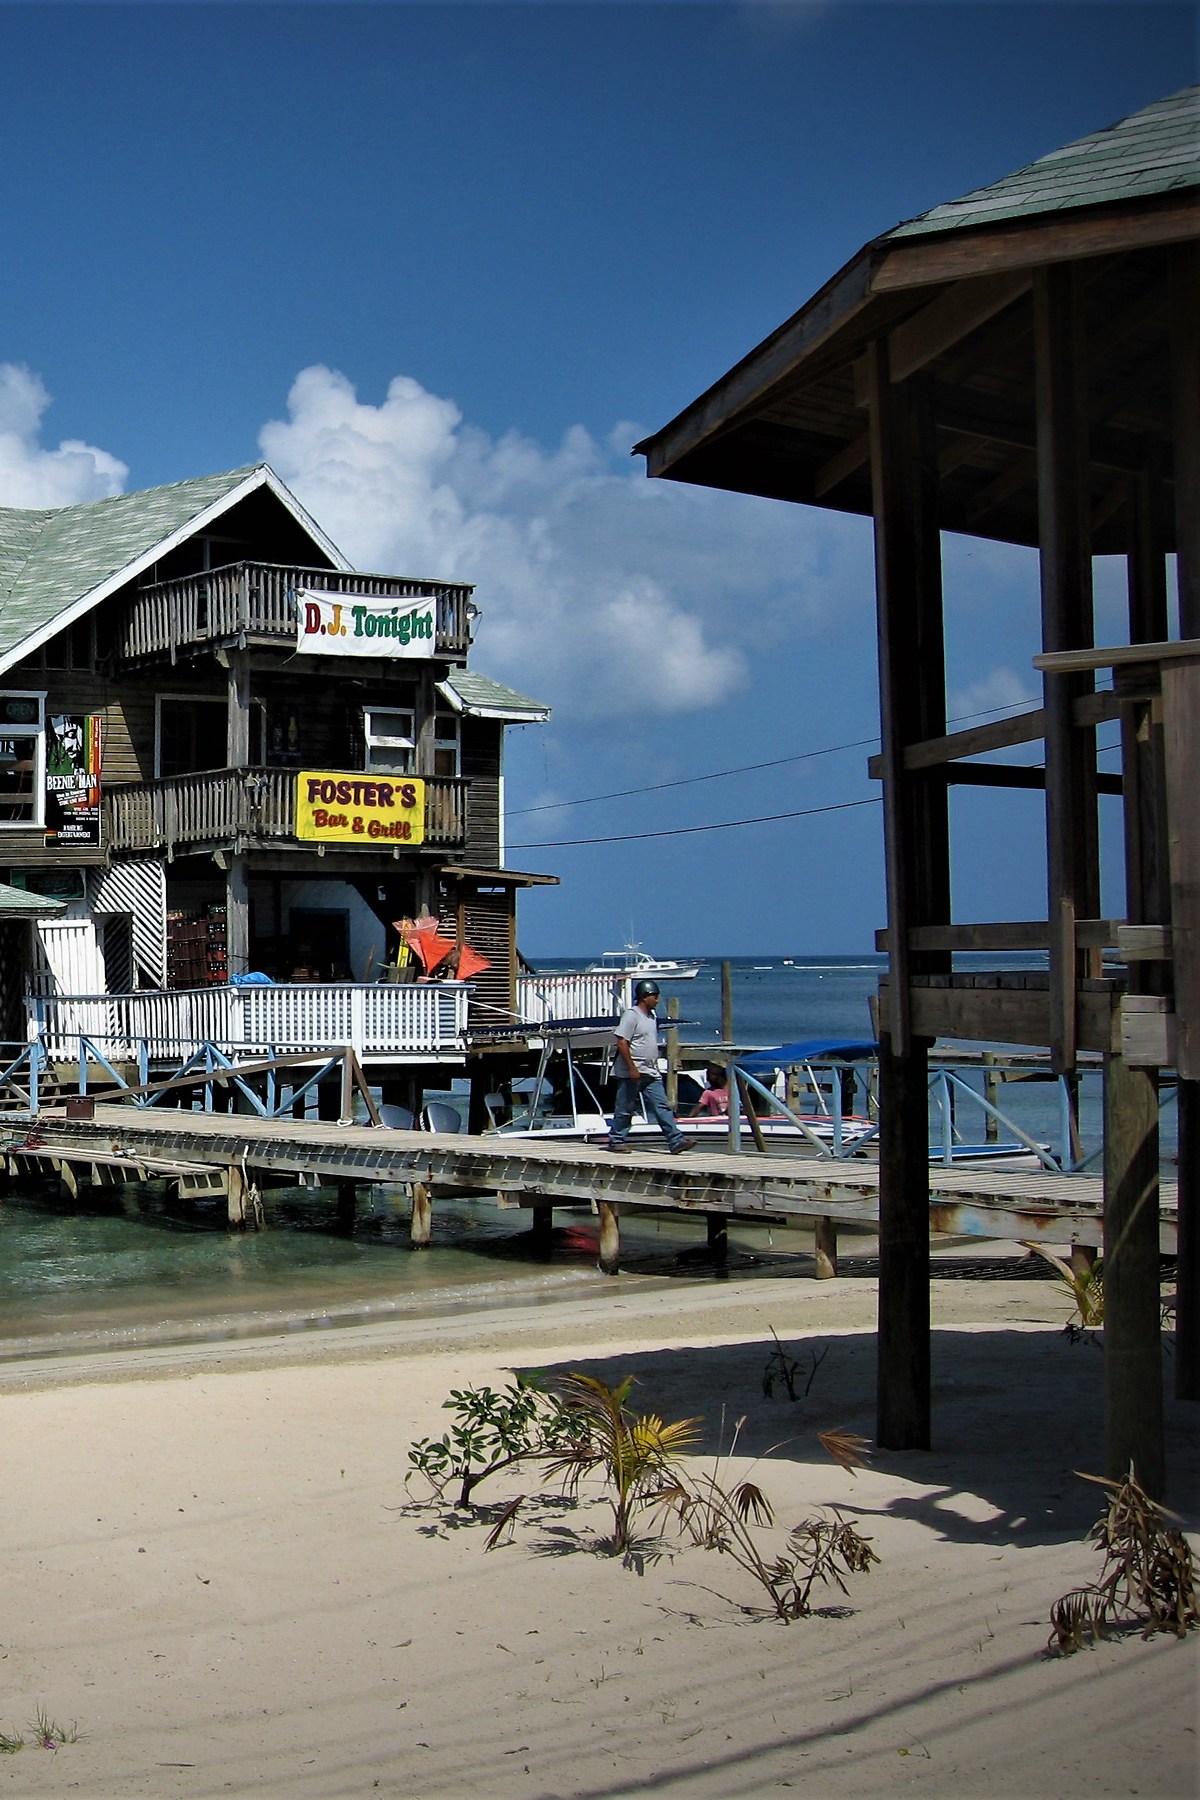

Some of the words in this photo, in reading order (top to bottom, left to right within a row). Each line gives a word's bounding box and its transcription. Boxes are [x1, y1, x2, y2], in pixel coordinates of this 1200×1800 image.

[305, 603, 347, 636] D.J.
[351, 606, 433, 645] Tonight
[46, 775, 76, 790] BEENIE
[78, 774, 97, 789] MAN
[307, 779, 417, 808] FOSTER'S
[312, 808, 349, 828] Bar
[352, 816, 364, 834] &
[367, 820, 412, 840] Grill
